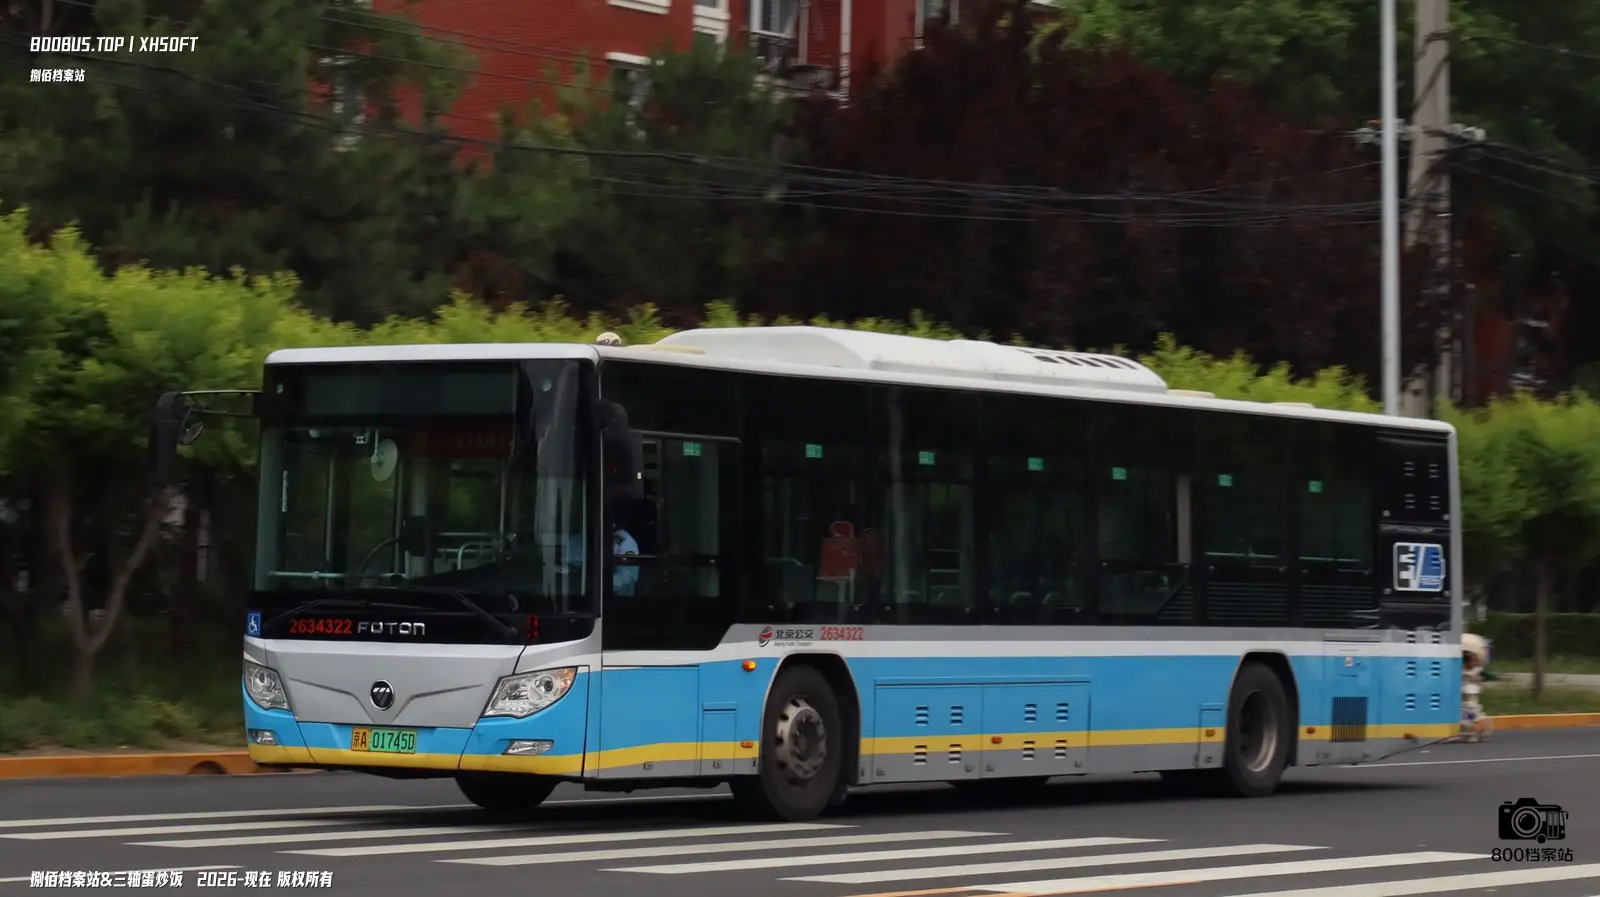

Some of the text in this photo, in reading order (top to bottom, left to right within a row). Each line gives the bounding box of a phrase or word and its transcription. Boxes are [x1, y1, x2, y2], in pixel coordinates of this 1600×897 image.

[290, 619, 425, 636] 2634322 FOTON
[775, 626, 863, 641] 北京公交 2634322
